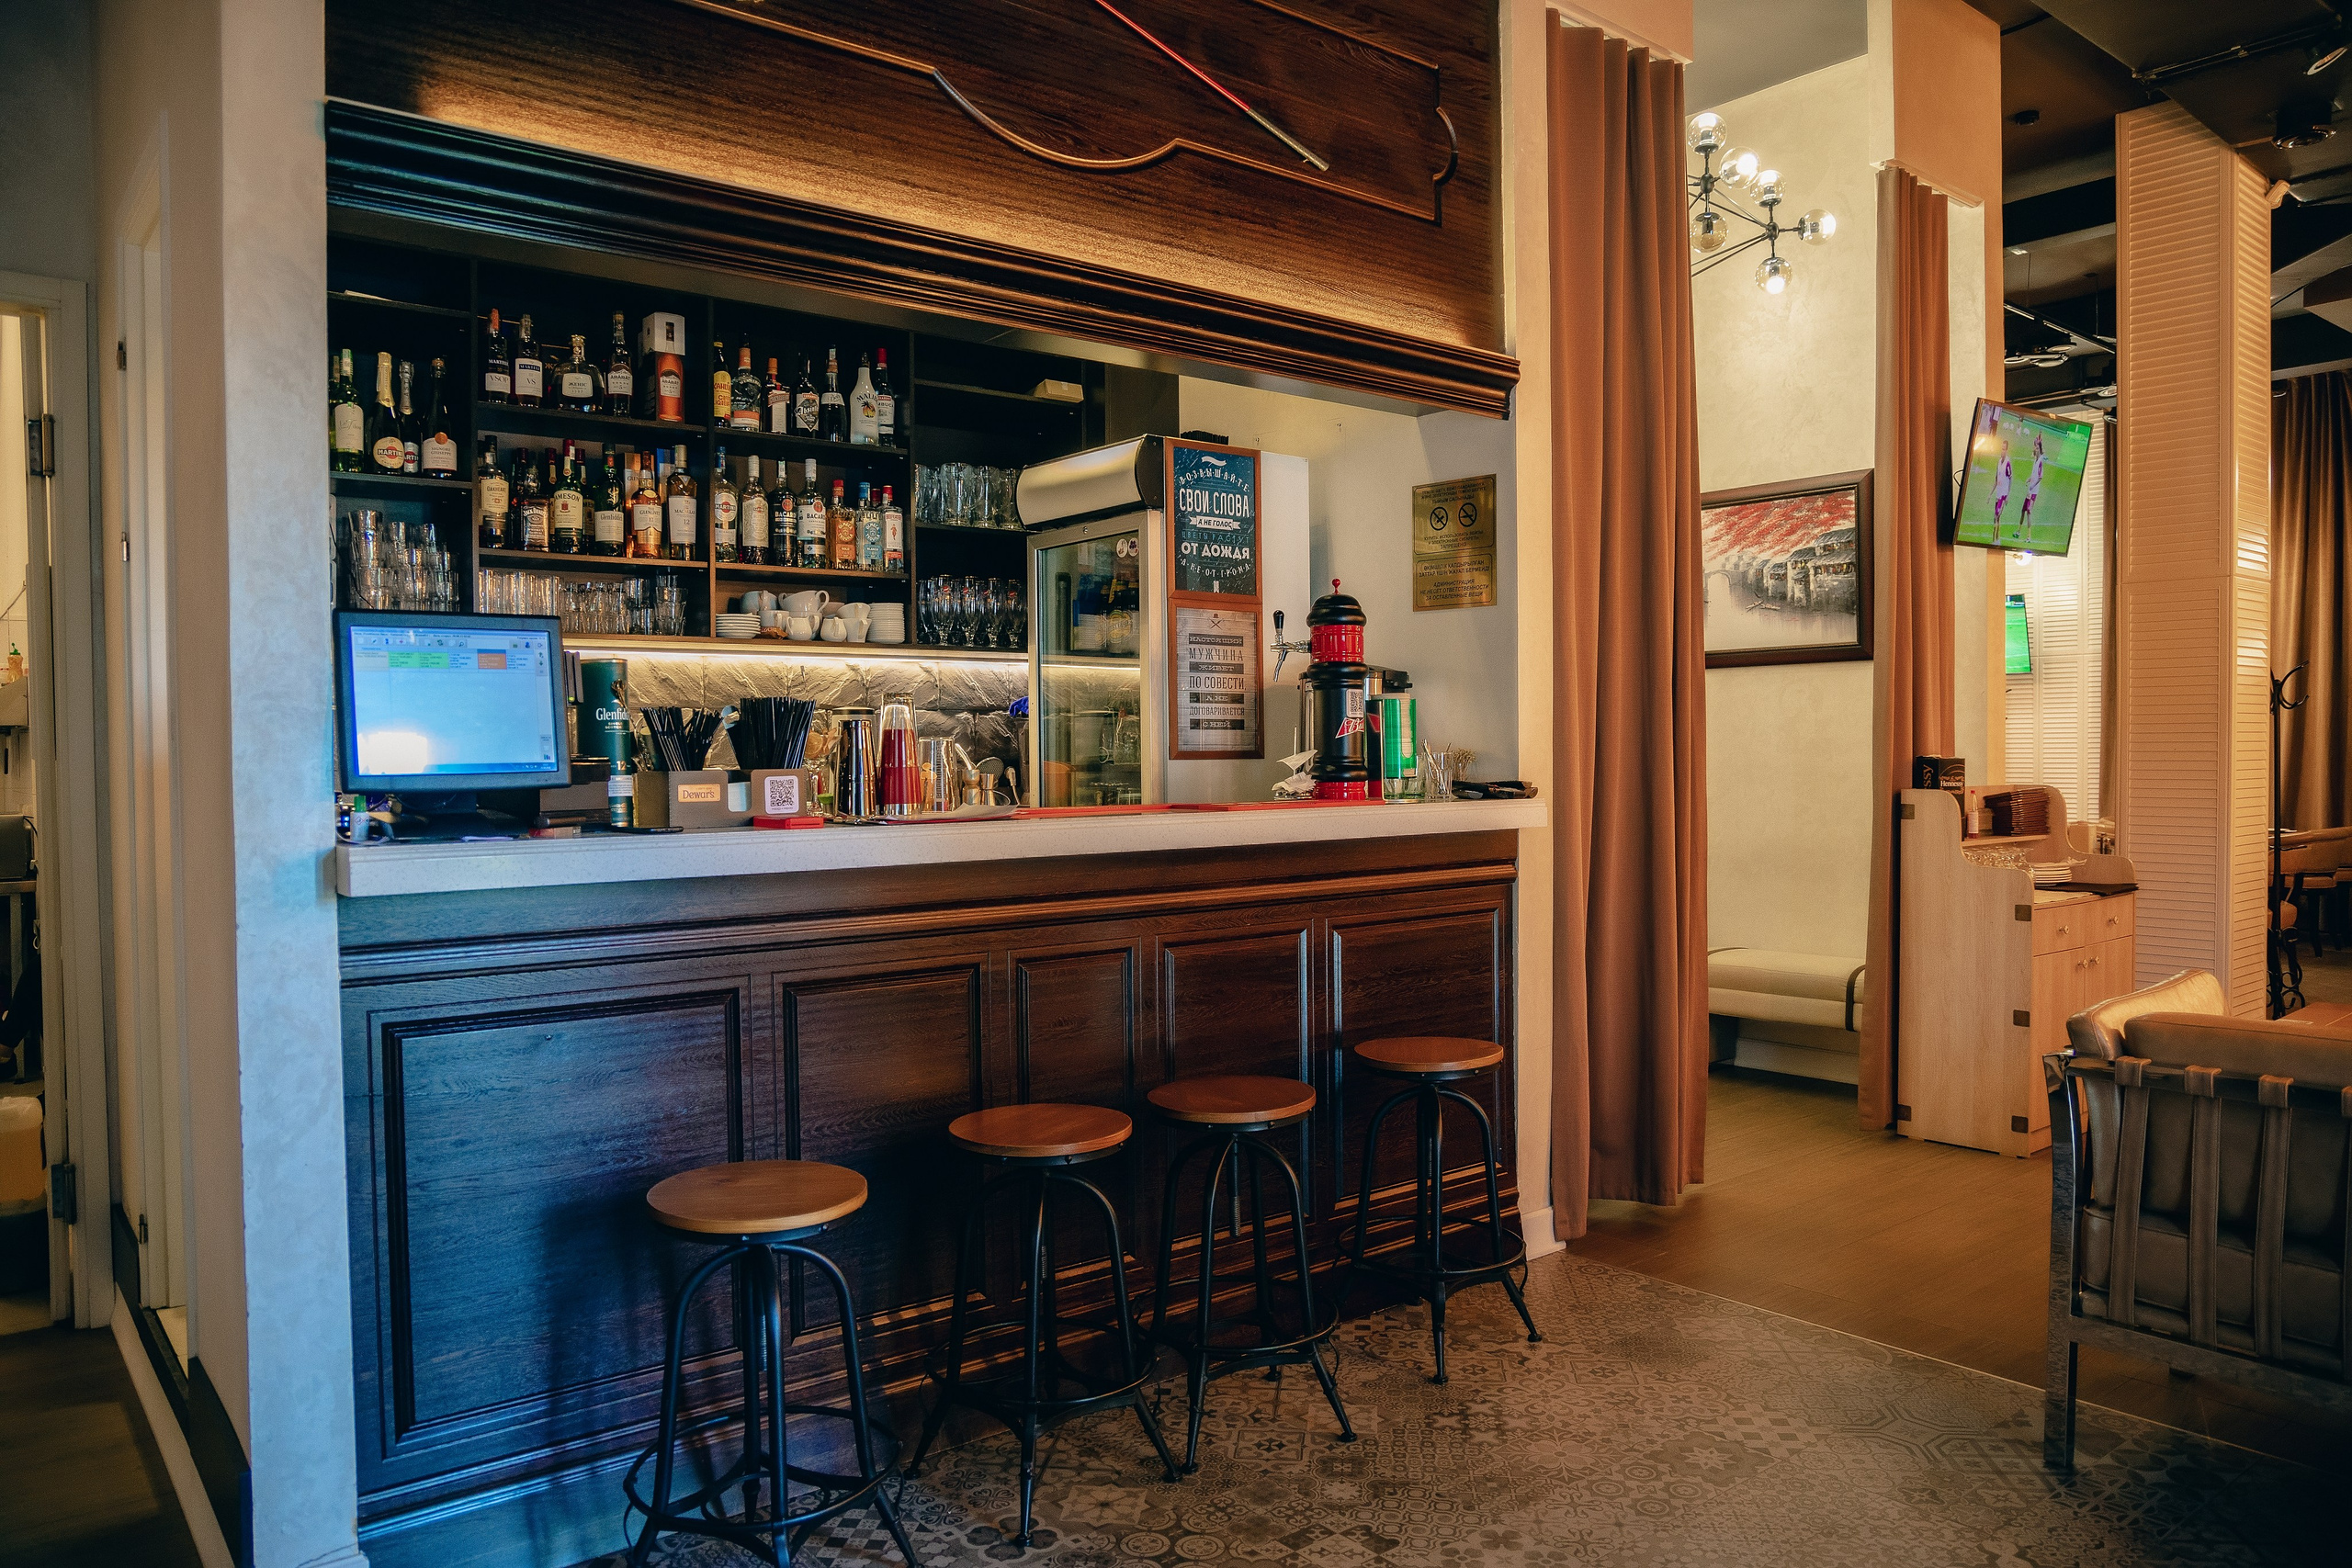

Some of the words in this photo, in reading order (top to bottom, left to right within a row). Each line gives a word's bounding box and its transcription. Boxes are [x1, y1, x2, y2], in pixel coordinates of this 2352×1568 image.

[489, 375, 509, 383] VSOP
[554, 492, 581, 502] AMESON
[1179, 488, 1209, 513] СВОИ
[1213, 491, 1250, 518] СЛОВА
[1213, 520, 1233, 529] ГОЛОС
[1182, 530, 1208, 540] ЦВЕТЫ
[1212, 533, 1250, 544] РАСТУТ
[1181, 541, 1198, 556] ОТ
[1201, 543, 1250, 559] ДОЖДЯ
[1433, 578, 1475, 588] АДМИНИСТРАЦИЯ
[1442, 584, 1489, 593] ОТВЕТСТВЕННОСТИ
[1189, 648, 1243, 661] МУЖЧИНА
[1189, 675, 1202, 689] ПО
[1204, 676, 1247, 691] СОВЕСТИ,
[1189, 705, 1245, 716] ДОГОВАРИВАЕТСЯ
[616, 761, 627, 771] 12
[1940, 780, 1964, 788] Hennessy
[683, 789, 715, 800] Dewar's
